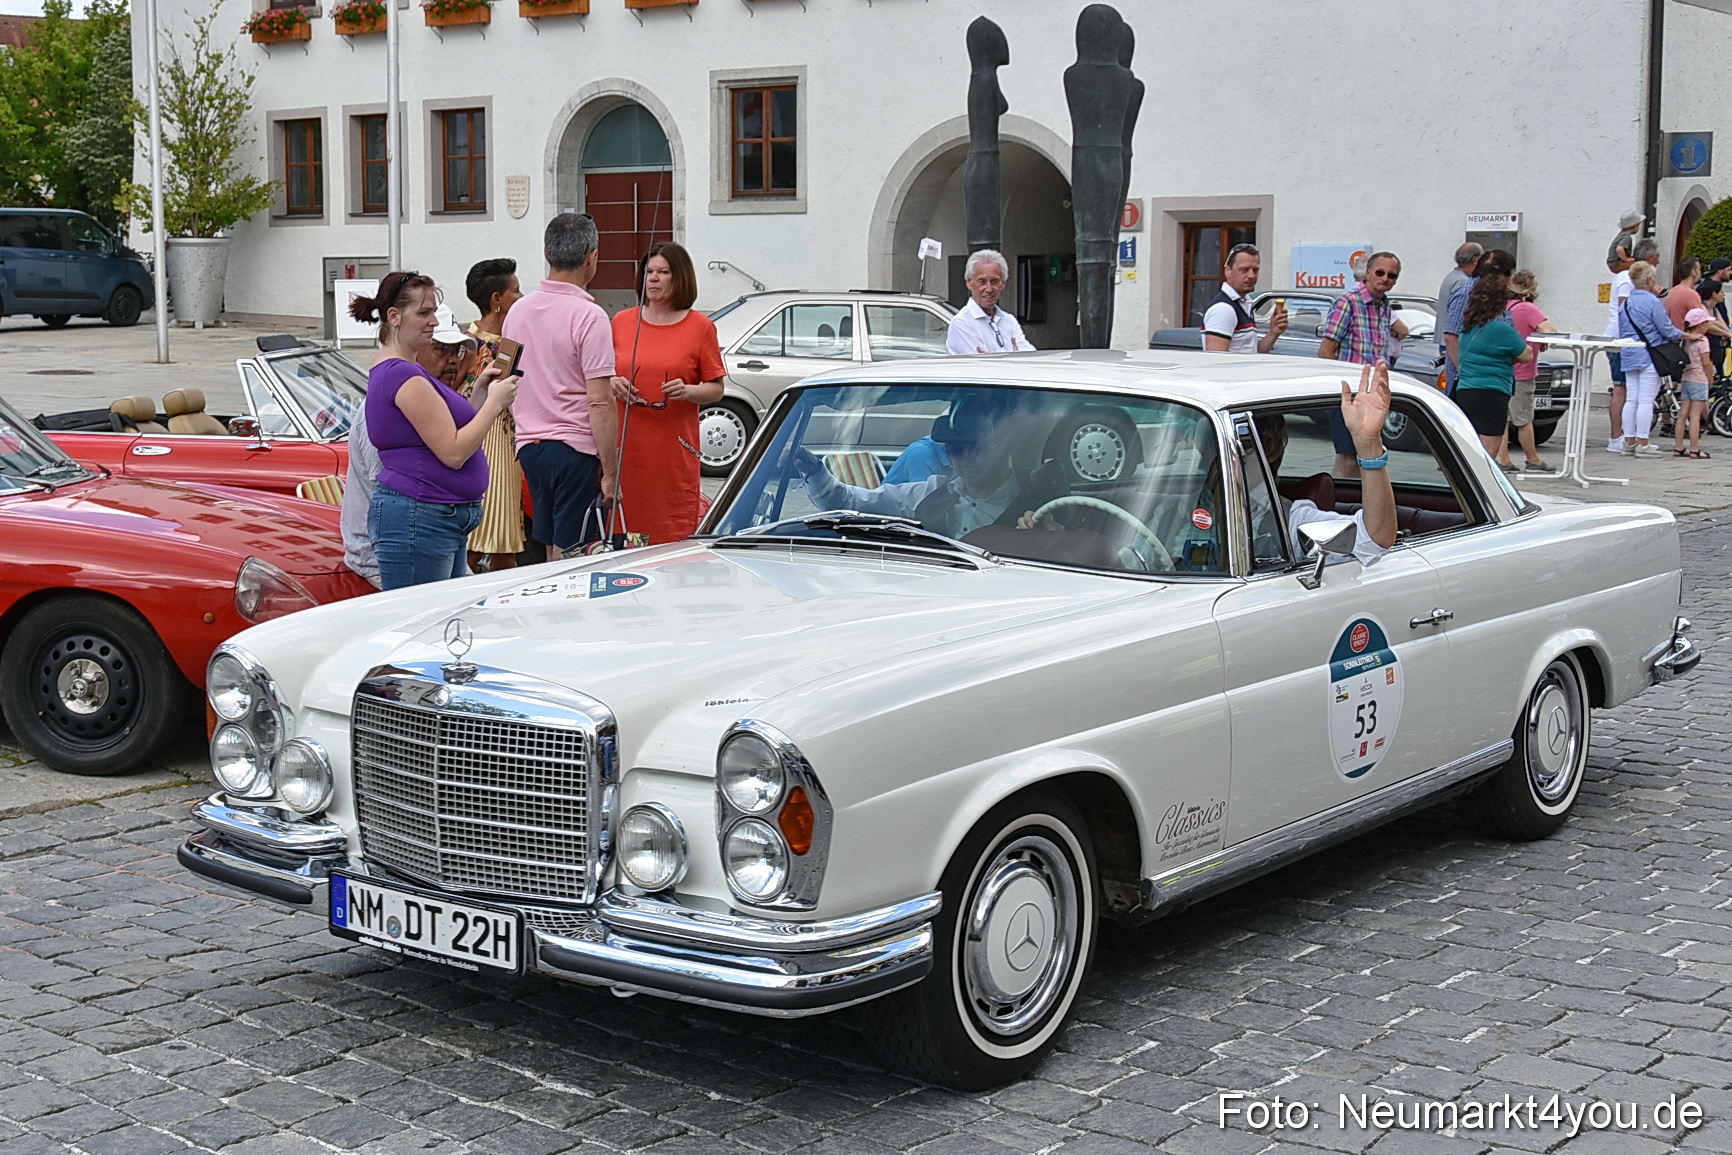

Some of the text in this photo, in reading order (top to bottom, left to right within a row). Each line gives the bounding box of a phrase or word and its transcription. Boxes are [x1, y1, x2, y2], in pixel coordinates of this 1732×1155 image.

[1295, 271, 1346, 287] Kunst
[1354, 699, 1377, 739] 53
[1155, 797, 1226, 845] Classics
[349, 885, 511, 963] NM DT 22H
